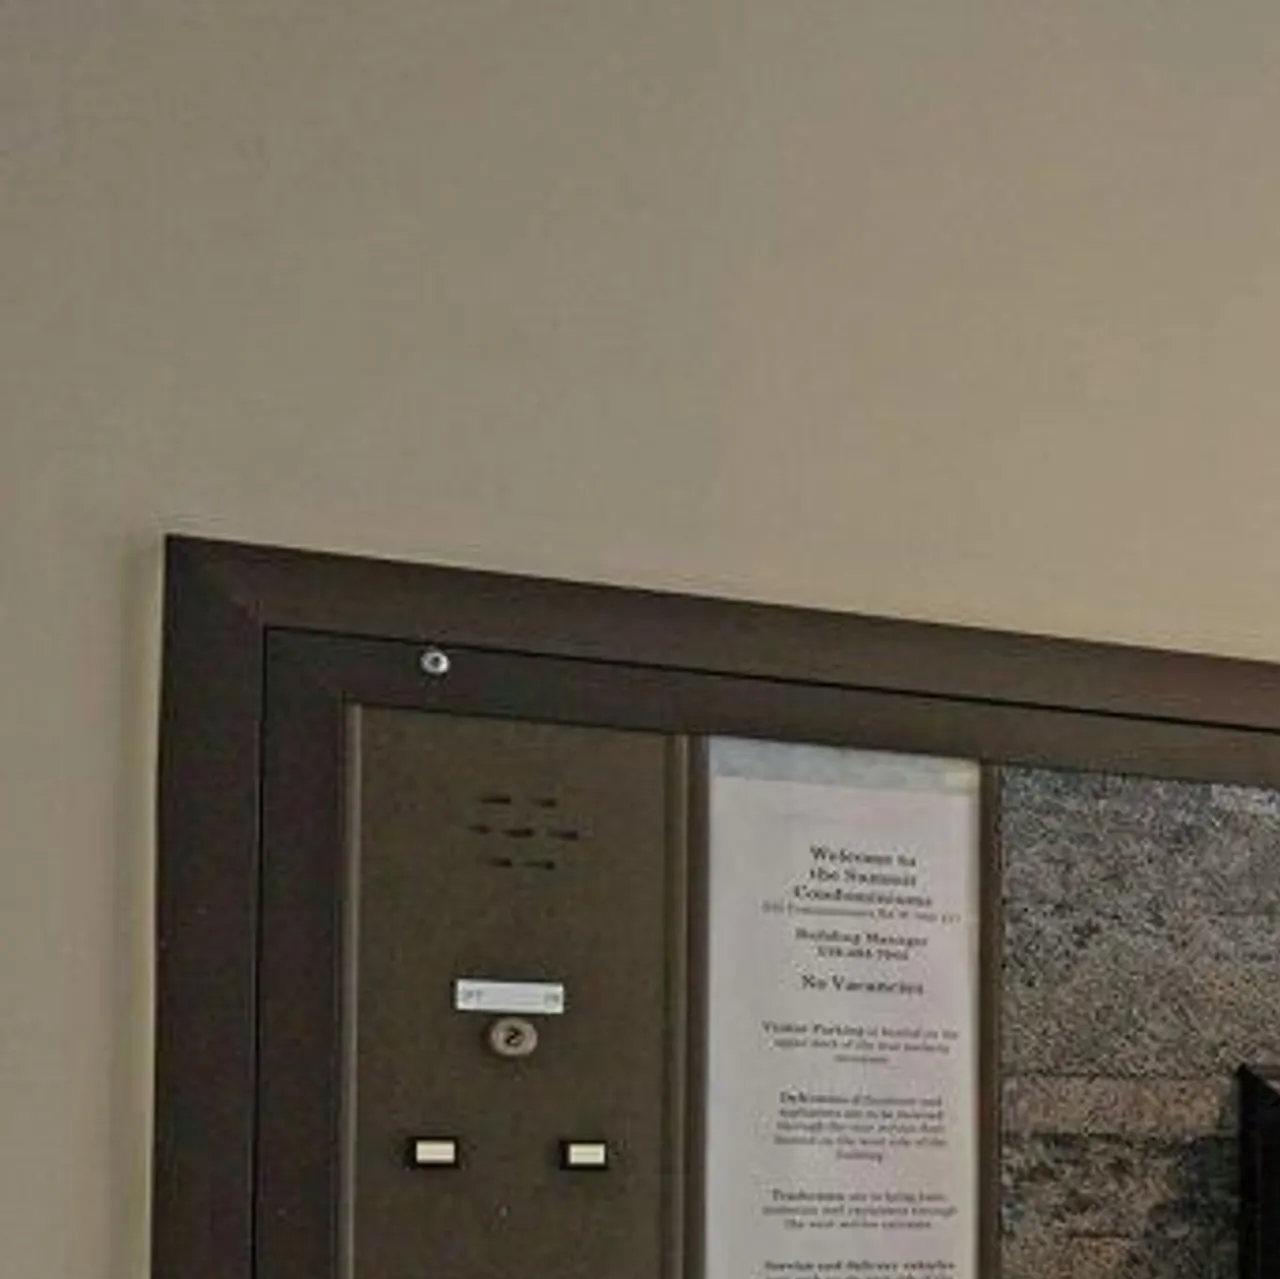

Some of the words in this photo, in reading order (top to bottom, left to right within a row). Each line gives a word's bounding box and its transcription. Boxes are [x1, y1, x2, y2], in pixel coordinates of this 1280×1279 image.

[809, 845, 893, 865] Welcome
[809, 867, 840, 883] the
[801, 974, 828, 992] No
